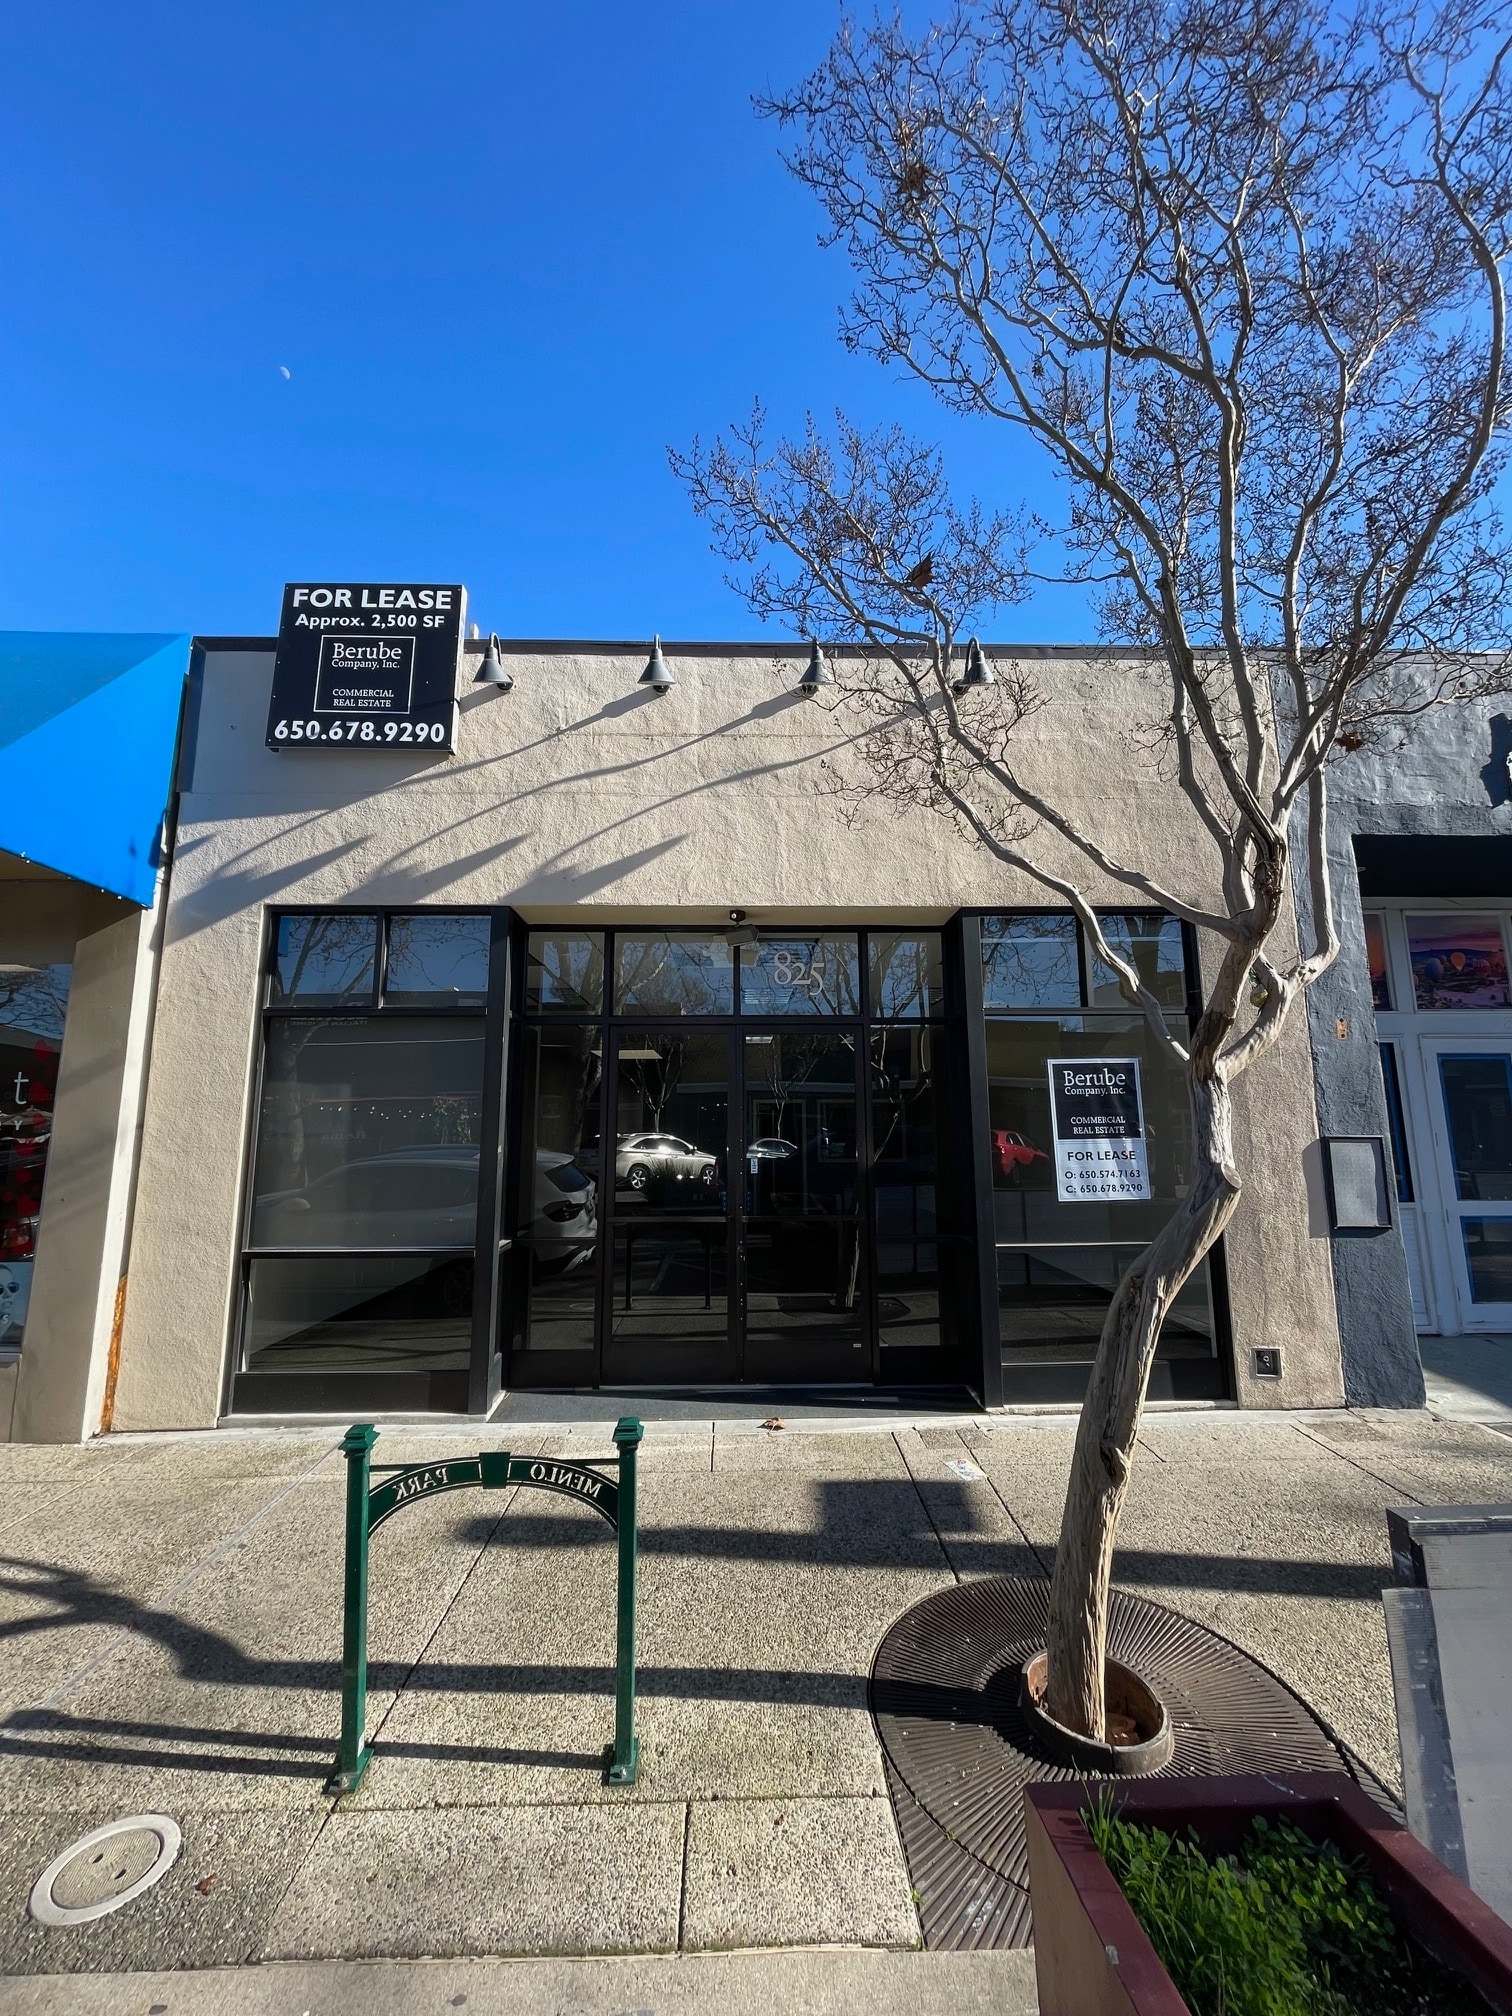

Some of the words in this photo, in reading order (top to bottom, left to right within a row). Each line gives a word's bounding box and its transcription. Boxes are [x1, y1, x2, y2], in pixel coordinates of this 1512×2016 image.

[292, 588, 352, 608] FOR
[361, 589, 452, 610] LEASE
[295, 613, 365, 629] Approx.
[371, 614, 417, 629] 2,500
[422, 615, 445, 628] SF
[332, 641, 402, 660] Berube
[382, 660, 400, 669] Inc.
[332, 688, 394, 698] COMMERCIAL
[333, 698, 355, 707] REAL
[358, 699, 391, 708] ESTATE
[274, 720, 445, 743] 650.678.9290
[773, 951, 825, 996] 825
[1063, 1068, 1126, 1087] Berube
[1110, 1086, 1126, 1095] Inc.
[1070, 1116, 1126, 1125] COMMERCIAL
[1073, 1126, 1094, 1135] REAL
[1095, 1126, 1125, 1134] ESTATE
[1067, 1151, 1094, 1162] FOR
[1097, 1150, 1137, 1161] LEASE
[1064, 1170, 1077, 1179] O:
[1079, 1169, 1141, 1179] 650.574.7163
[1065, 1185, 1077, 1194] C:
[1080, 1183, 1143, 1193] 650.678.9290
